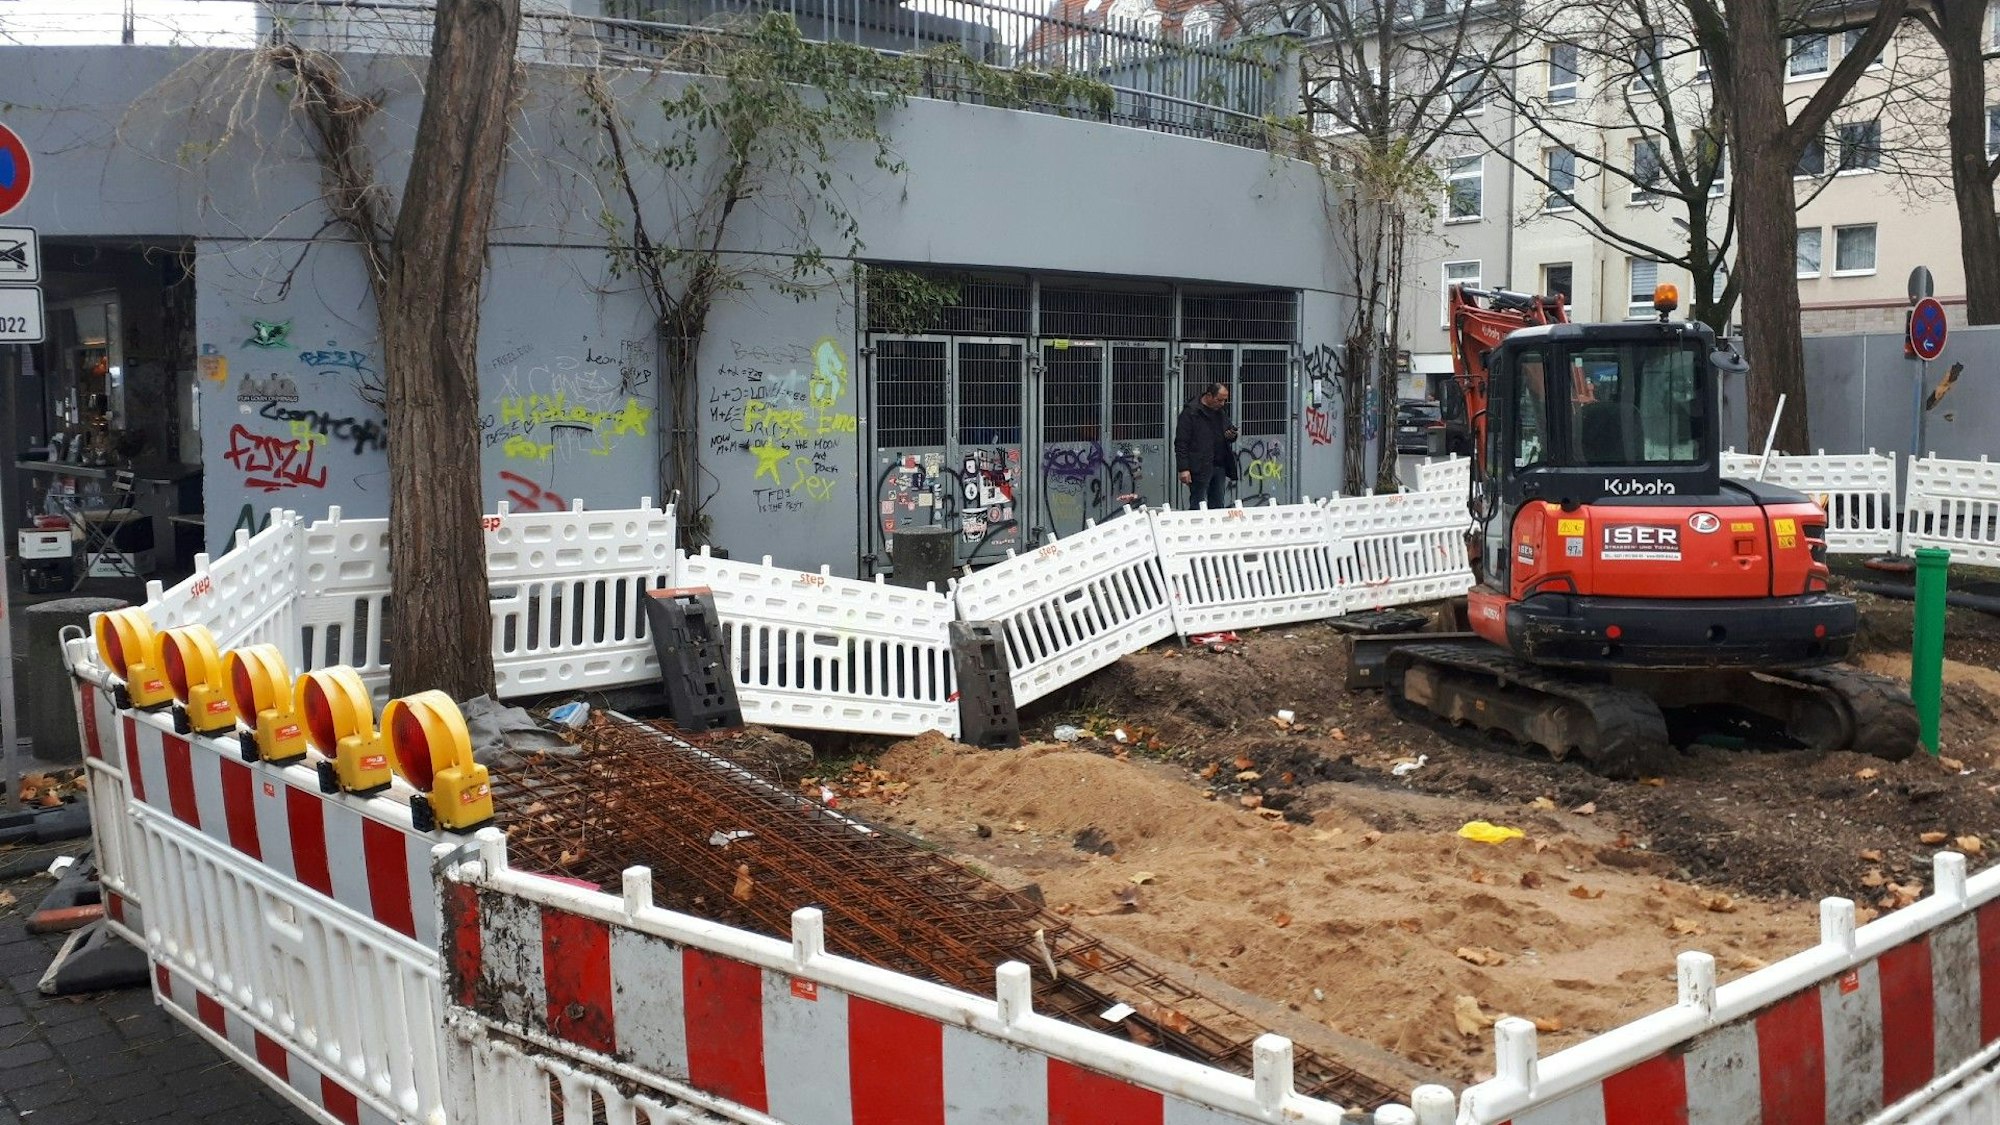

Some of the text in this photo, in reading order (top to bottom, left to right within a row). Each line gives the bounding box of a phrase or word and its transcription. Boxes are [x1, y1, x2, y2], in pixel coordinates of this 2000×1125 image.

[1604, 479, 1676, 495] Kubota
[1227, 510, 1244, 520] step
[481, 517, 501, 531] ep
[1604, 527, 1678, 545] ISER
[1038, 544, 1057, 557] step
[190, 575, 210, 599] step
[799, 573, 825, 588] step
